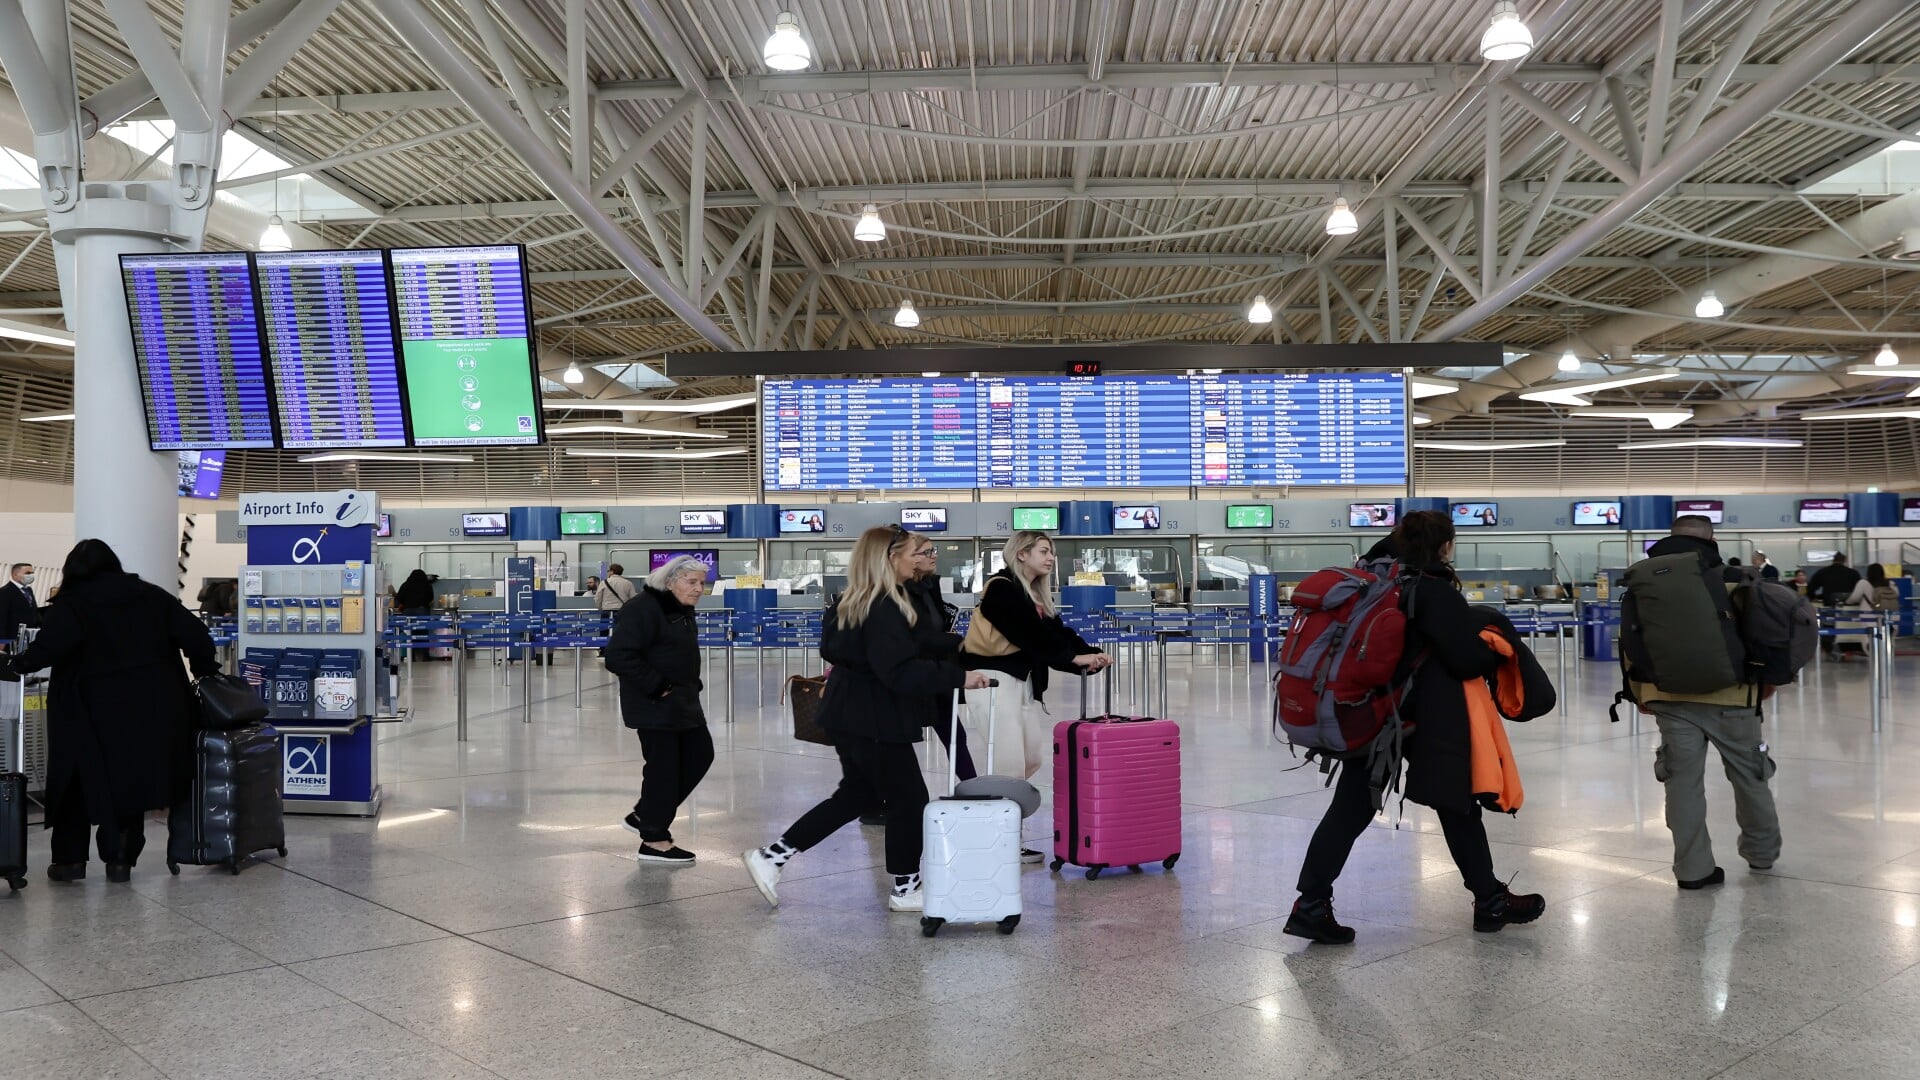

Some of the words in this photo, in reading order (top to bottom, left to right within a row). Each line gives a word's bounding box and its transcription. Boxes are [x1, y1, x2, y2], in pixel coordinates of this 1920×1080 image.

[244, 502, 291, 518] Airport
[296, 501, 324, 514] Info
[996, 521, 1008, 531] 54
[1167, 520, 1178, 530] 53
[1279, 519, 1290, 529] 52
[1330, 518, 1341, 528] 51
[1502, 518, 1514, 527] 50
[400, 528, 411, 537] 60
[449, 528, 460, 537] 59
[615, 526, 626, 535] 58
[664, 525, 675, 534] 57
[832, 523, 844, 533] 56
[287, 776, 327, 785] ATHENS
